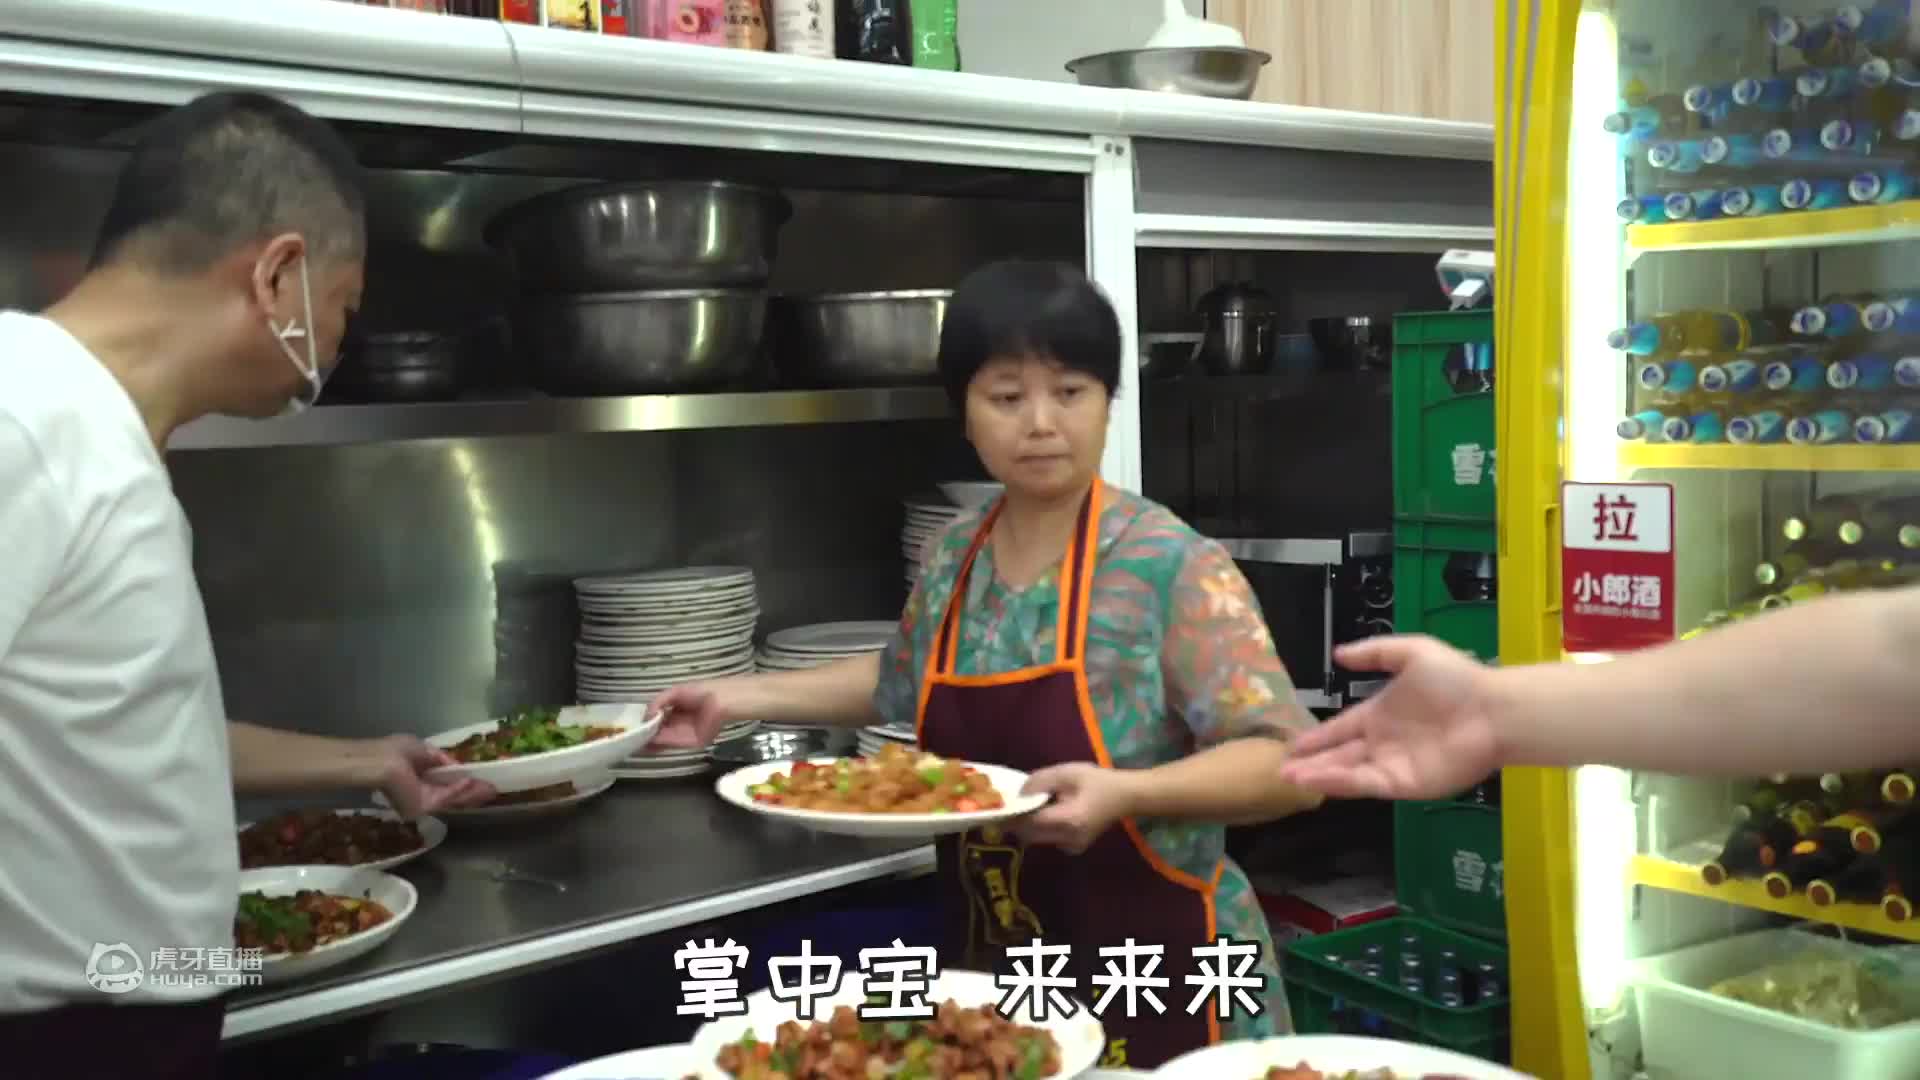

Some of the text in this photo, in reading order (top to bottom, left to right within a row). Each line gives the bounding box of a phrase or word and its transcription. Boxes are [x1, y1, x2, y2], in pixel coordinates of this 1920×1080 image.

[1451, 443, 1496, 485] 雪
[1593, 493, 1639, 541] 拉
[1573, 572, 1662, 608] 小郎酒
